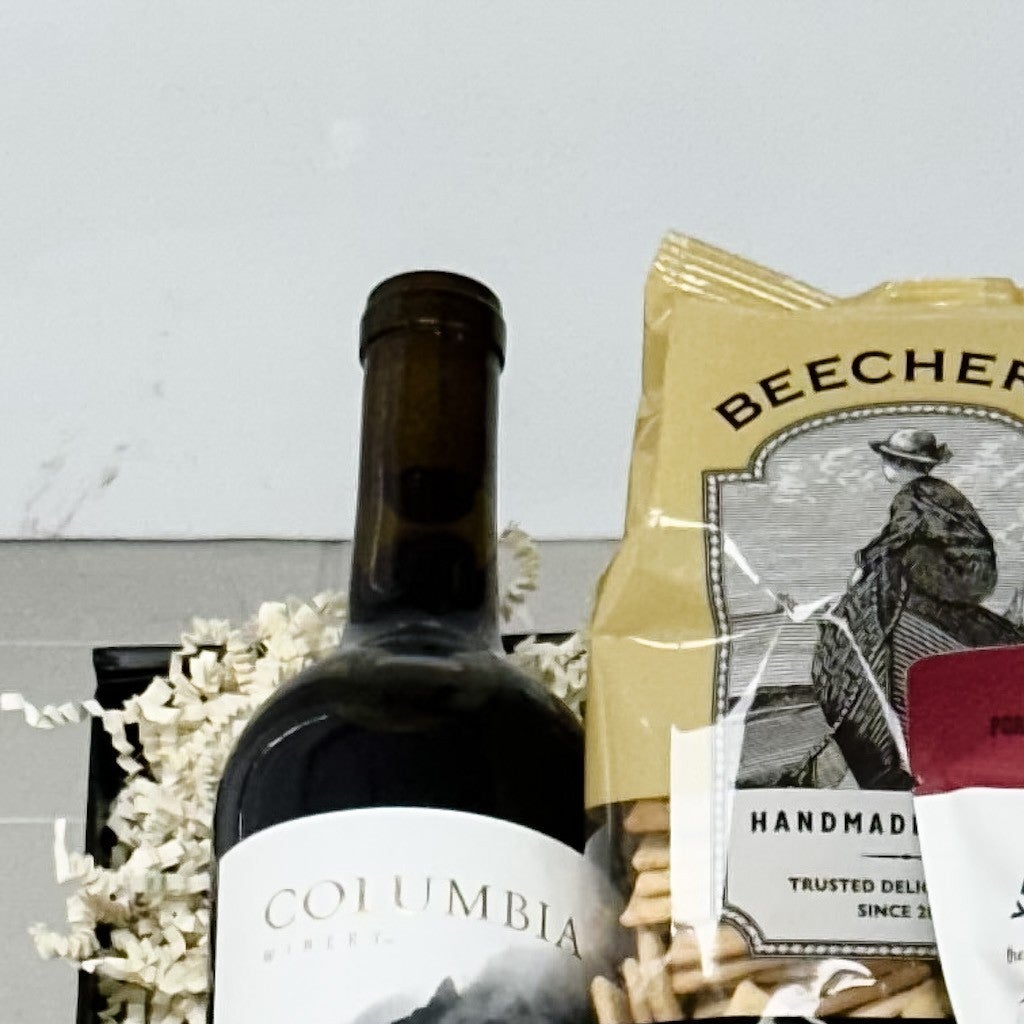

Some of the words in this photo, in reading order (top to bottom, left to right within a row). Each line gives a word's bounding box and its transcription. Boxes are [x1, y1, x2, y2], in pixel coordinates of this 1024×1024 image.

[788, 876, 875, 893] TRUSTED
[263, 874, 582, 960] COLUMBIA
[857, 903, 911, 918] SINCE
